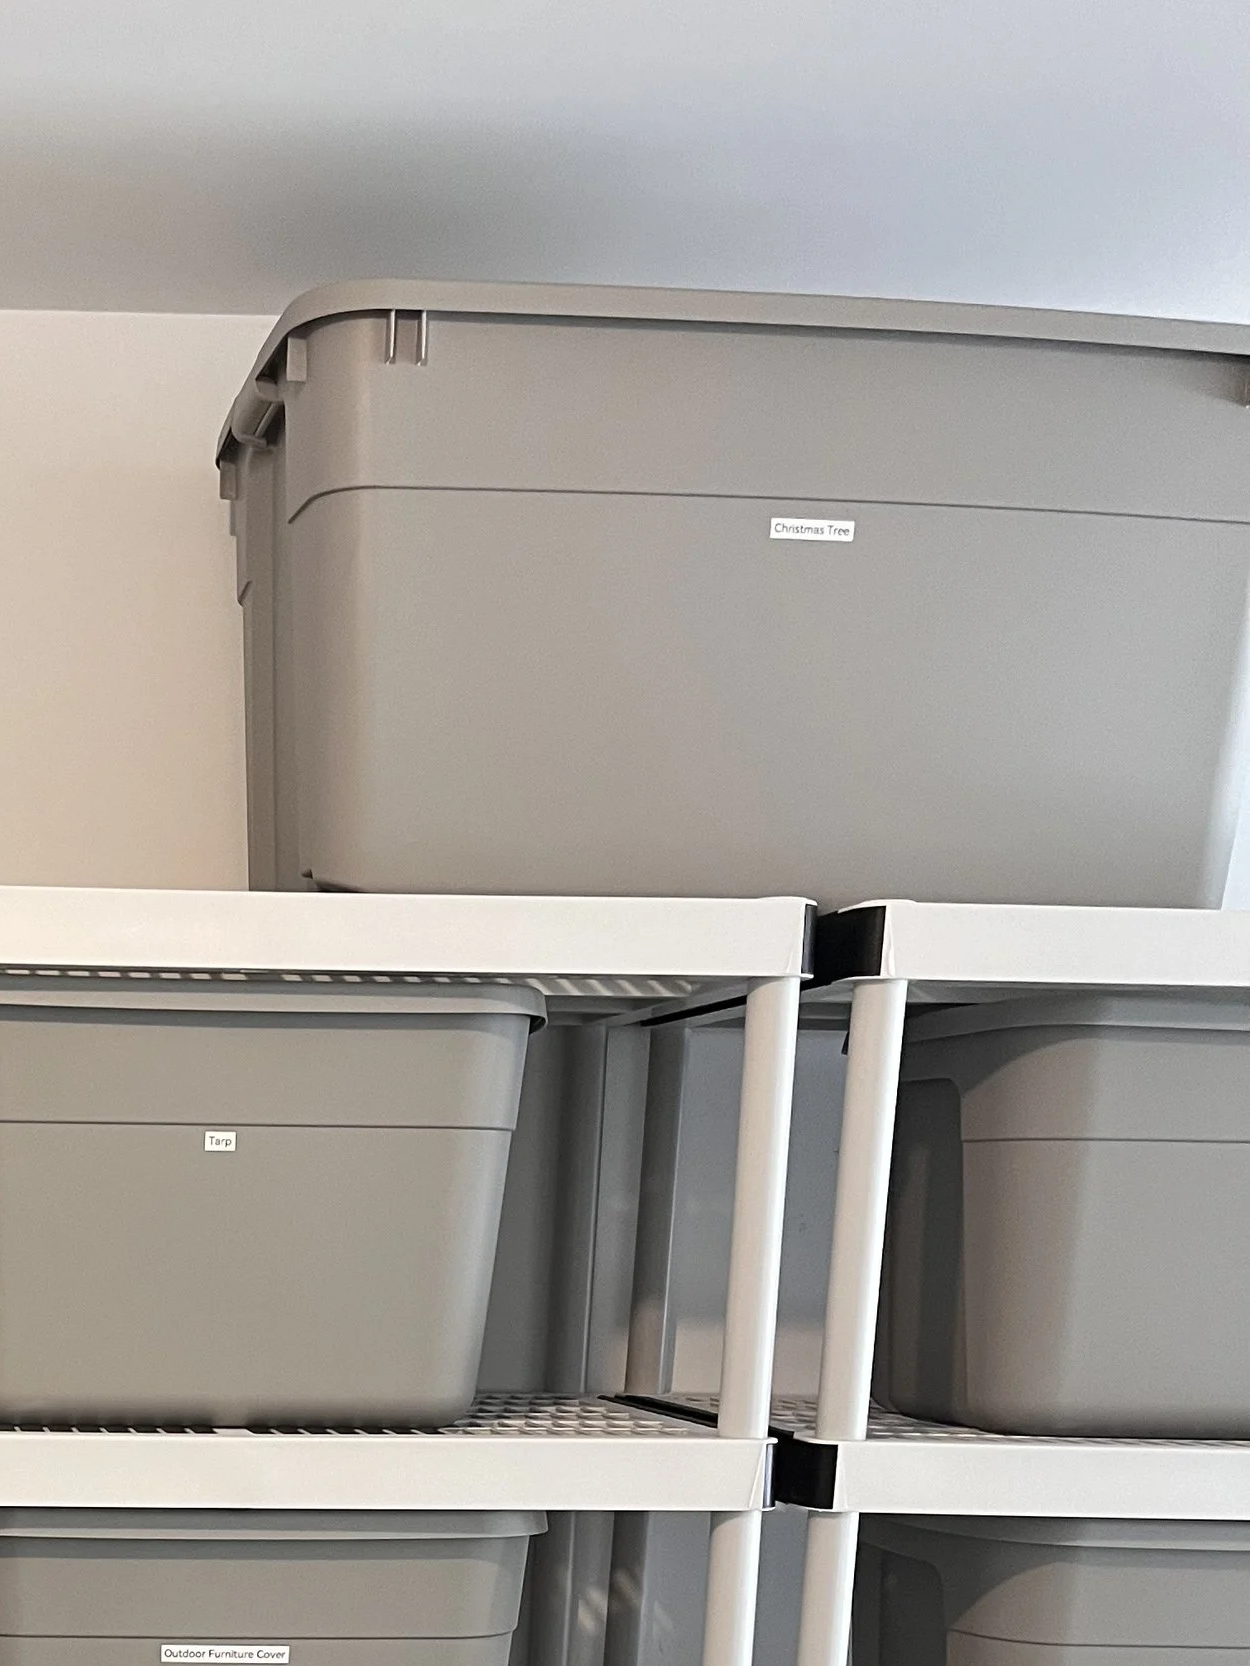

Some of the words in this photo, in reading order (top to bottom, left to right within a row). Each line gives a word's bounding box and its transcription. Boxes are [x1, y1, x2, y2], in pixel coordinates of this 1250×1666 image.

[774, 522, 824, 535] Christmas
[827, 525, 850, 536] Tree
[208, 1135, 232, 1148] Tarp
[164, 1648, 206, 1658] Outdoor
[208, 1649, 254, 1659] Furniture
[256, 1650, 286, 1659] Cover
